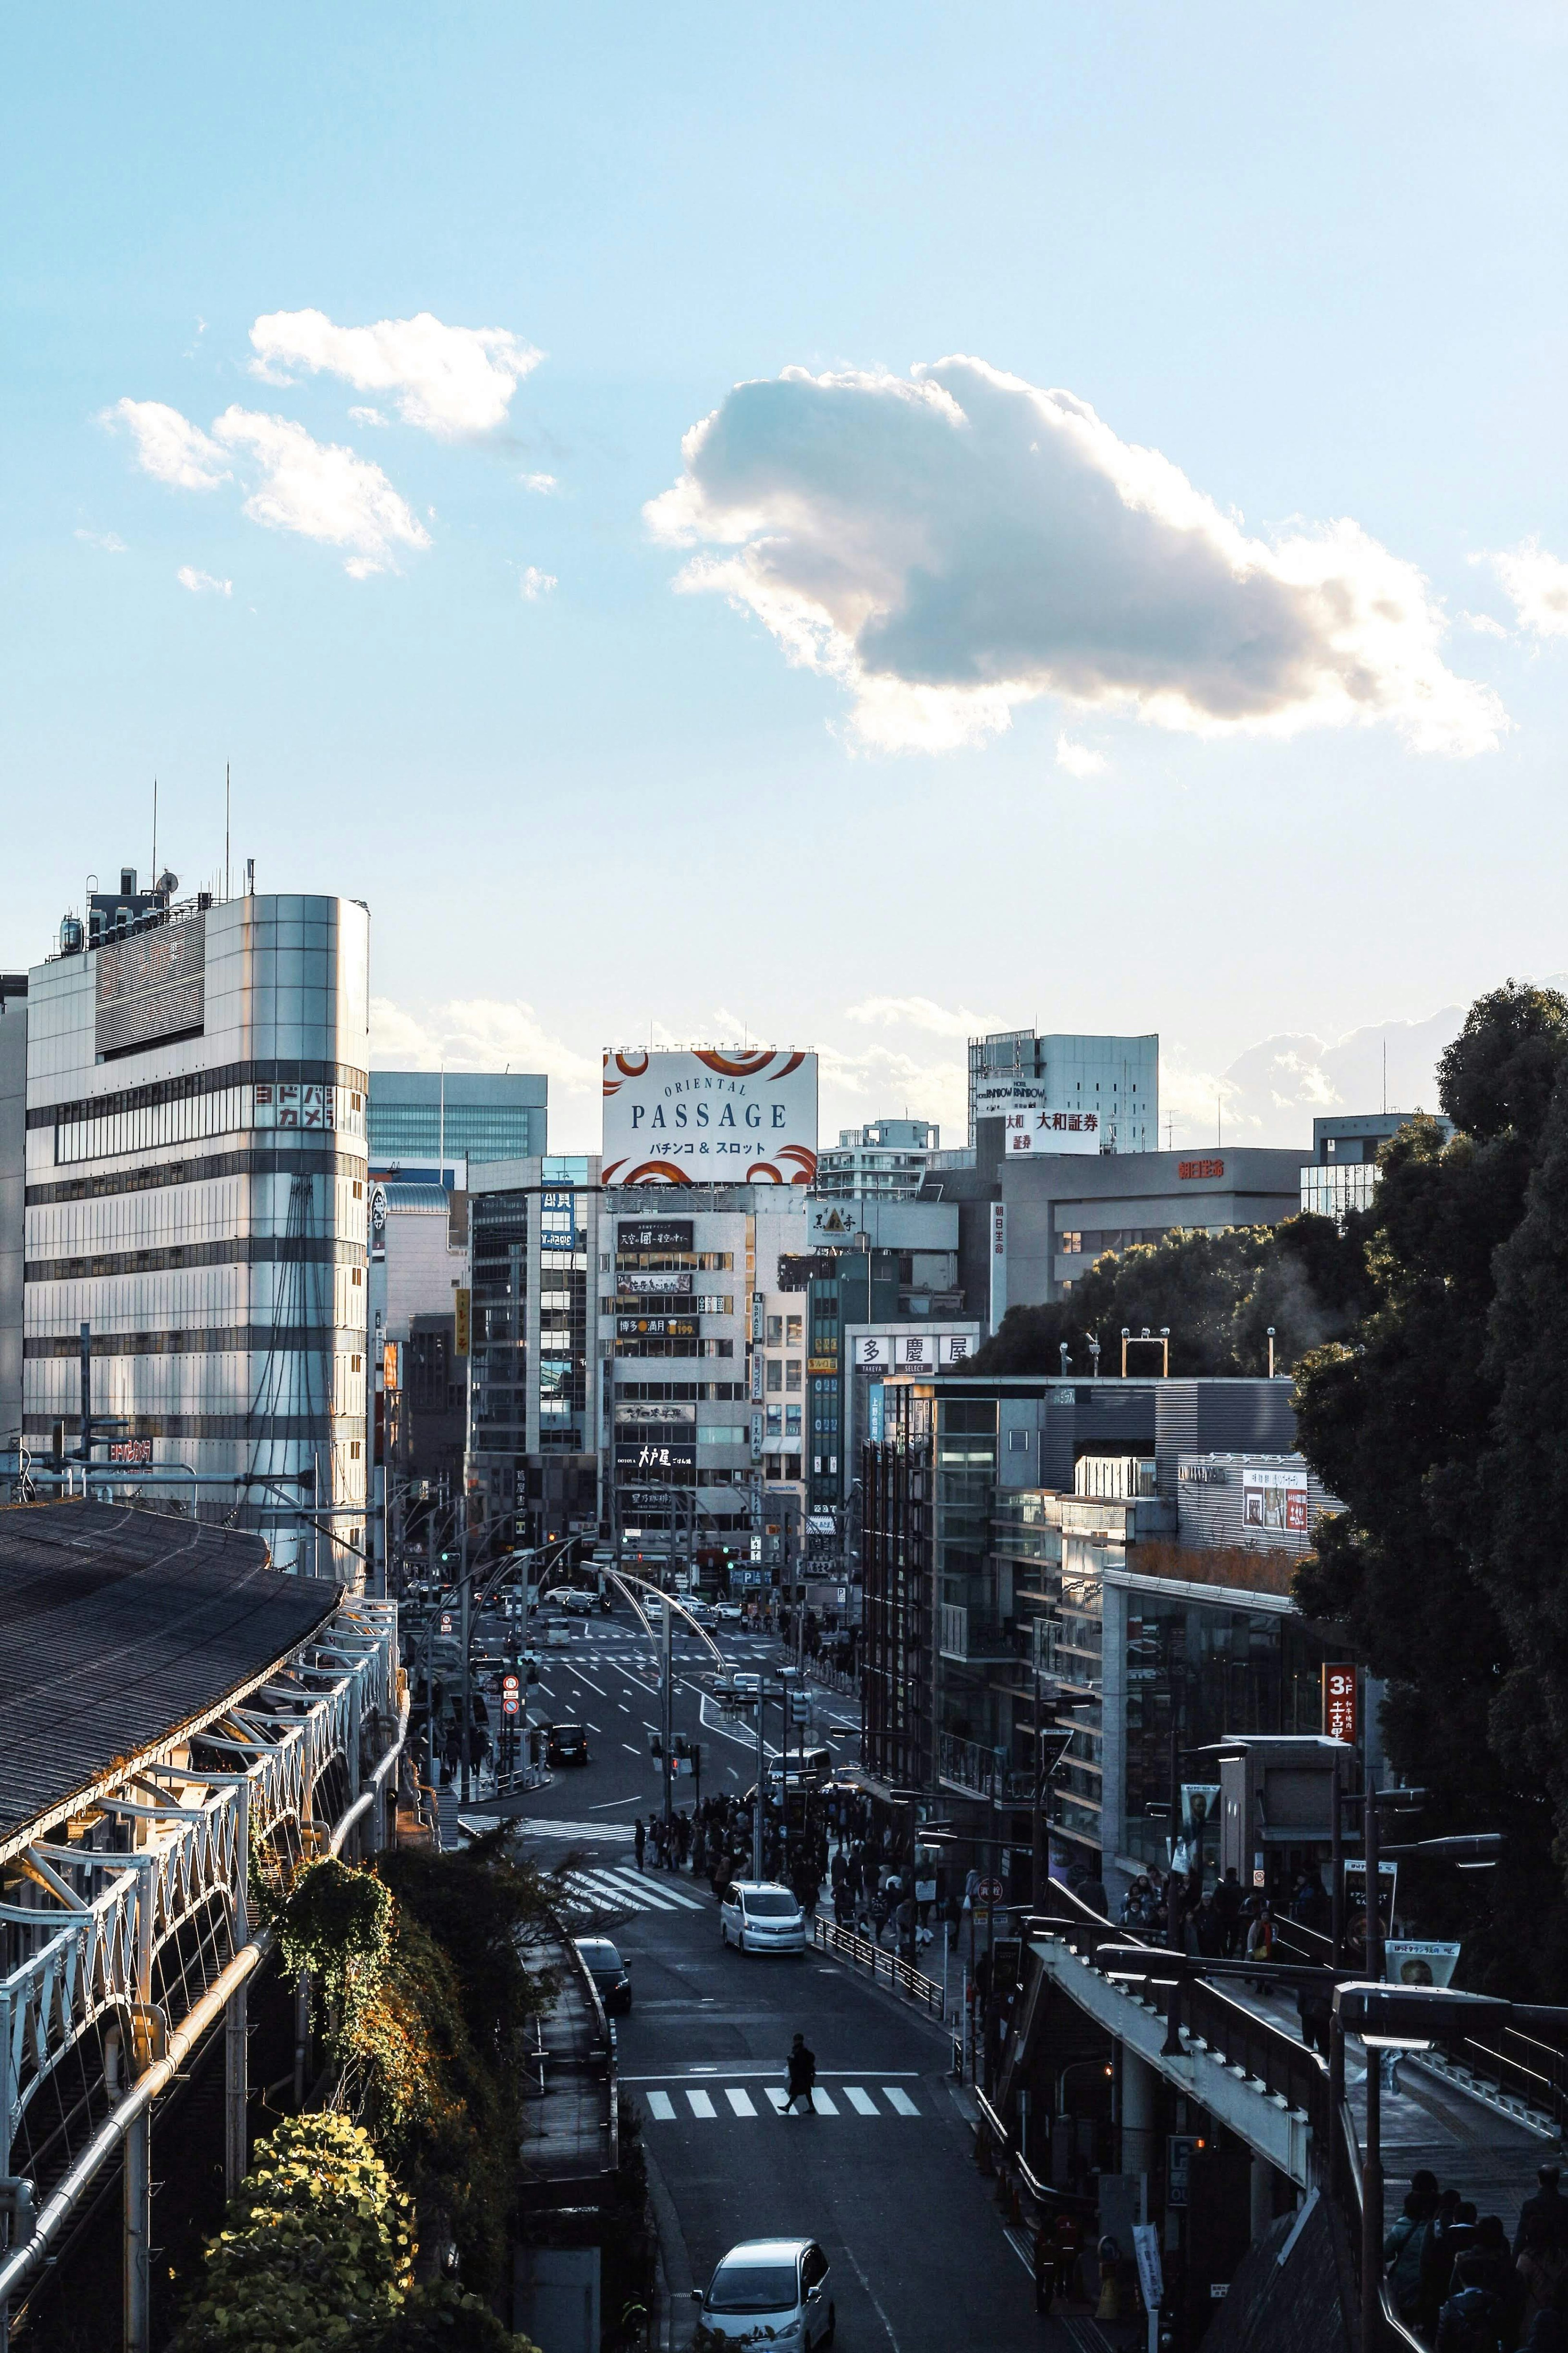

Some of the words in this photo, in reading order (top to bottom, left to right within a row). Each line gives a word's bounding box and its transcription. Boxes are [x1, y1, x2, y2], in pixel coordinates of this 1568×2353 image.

[665, 1077, 746, 1097] ORIENTAL
[987, 1087, 1012, 1098] RAINBOW
[1013, 1087, 1045, 1098] RAINBOW
[631, 1103, 786, 1129] PASSAGE
[1006, 1115, 1024, 1129] 大和
[1036, 1112, 1098, 1132] 大和証券
[650, 1142, 694, 1155] パチンコ
[699, 1142, 709, 1154] &
[717, 1142, 765, 1155] スロット
[1013, 1135, 1031, 1150] 証券
[1178, 1159, 1224, 1180] 朝日生命
[995, 1206, 1004, 1254] 朝日生命
[620, 1320, 638, 1332] 博多
[647, 1320, 664, 1332] 満月
[863, 1337, 967, 1363] 多慶屋
[638, 1445, 671, 1468] 大戸屋
[744, 1572, 751, 1583] P
[1330, 1675, 1353, 1695] 3F
[1329, 1700, 1345, 1740] 土古里
[981, 1886, 1000, 1896] 消栓
[1394, 1945, 1439, 1954] ほっとタウンうえの
